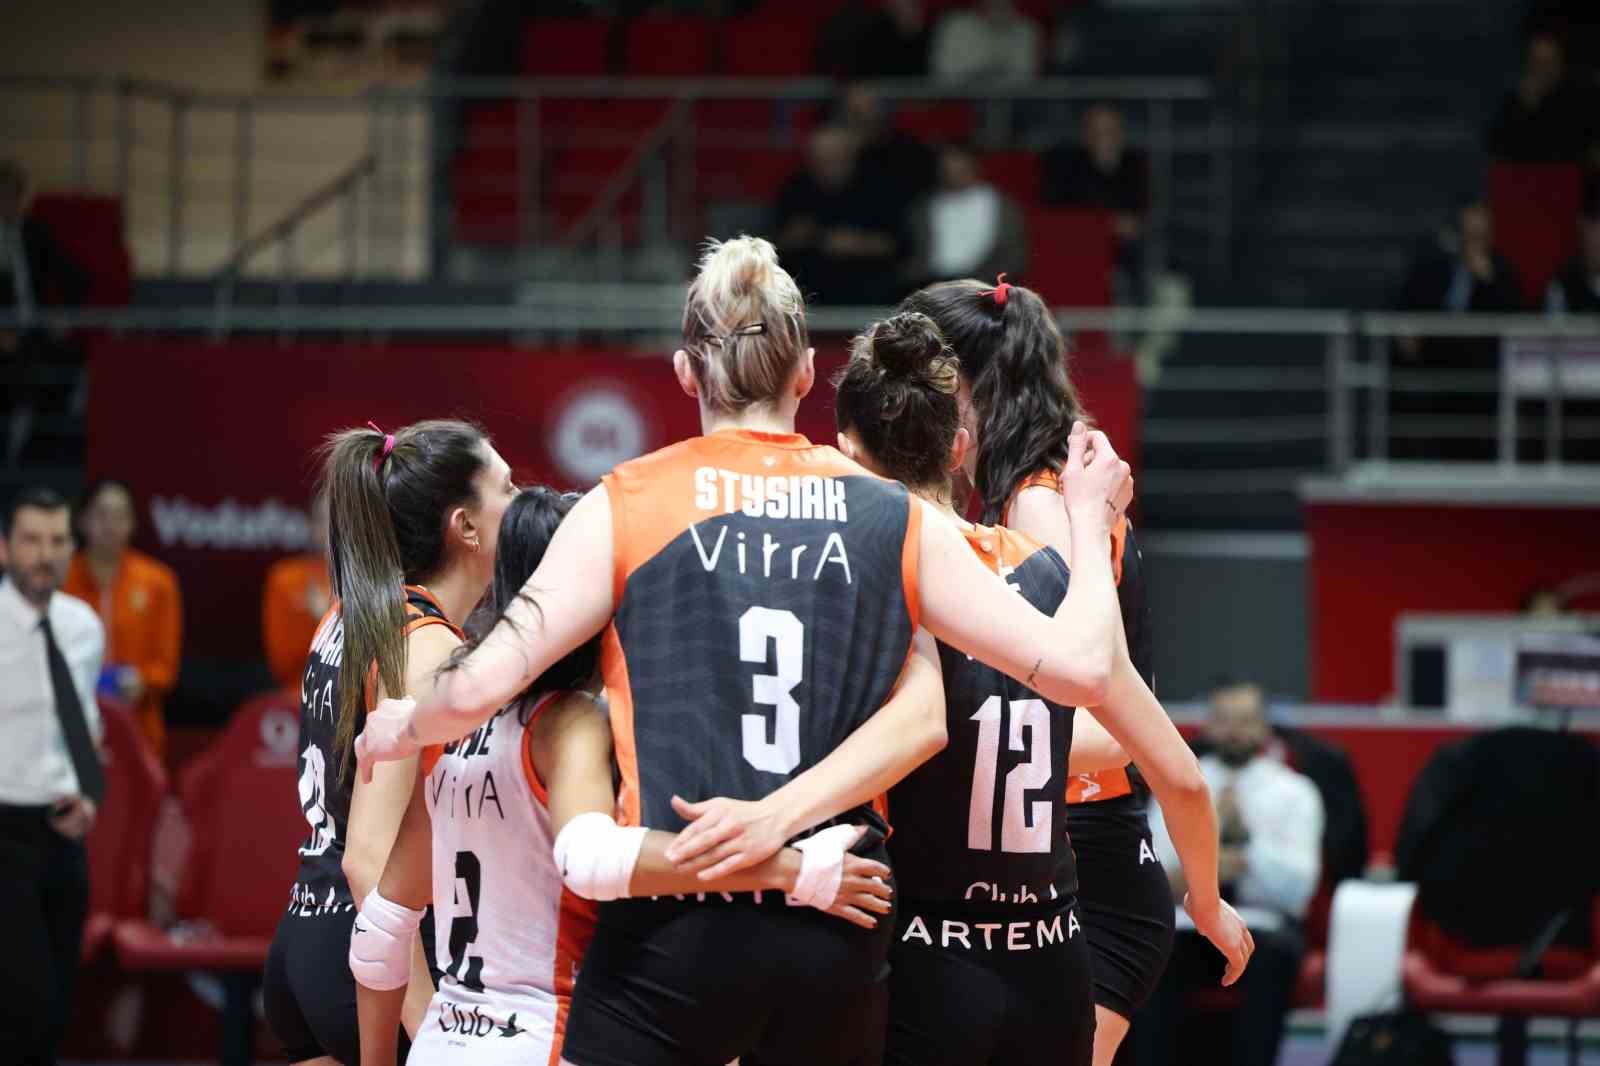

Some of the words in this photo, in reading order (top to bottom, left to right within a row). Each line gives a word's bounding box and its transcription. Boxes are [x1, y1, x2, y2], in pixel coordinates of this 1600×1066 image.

[695, 466, 848, 522] STYSIAK
[150, 495, 312, 549] Vodafo
[689, 522, 852, 585] VitrA
[738, 606, 804, 775] 3
[431, 769, 504, 820] VirA
[967, 695, 1053, 853] 12
[902, 909, 1081, 951] ARTEMA
[438, 1002, 494, 1037] Club
